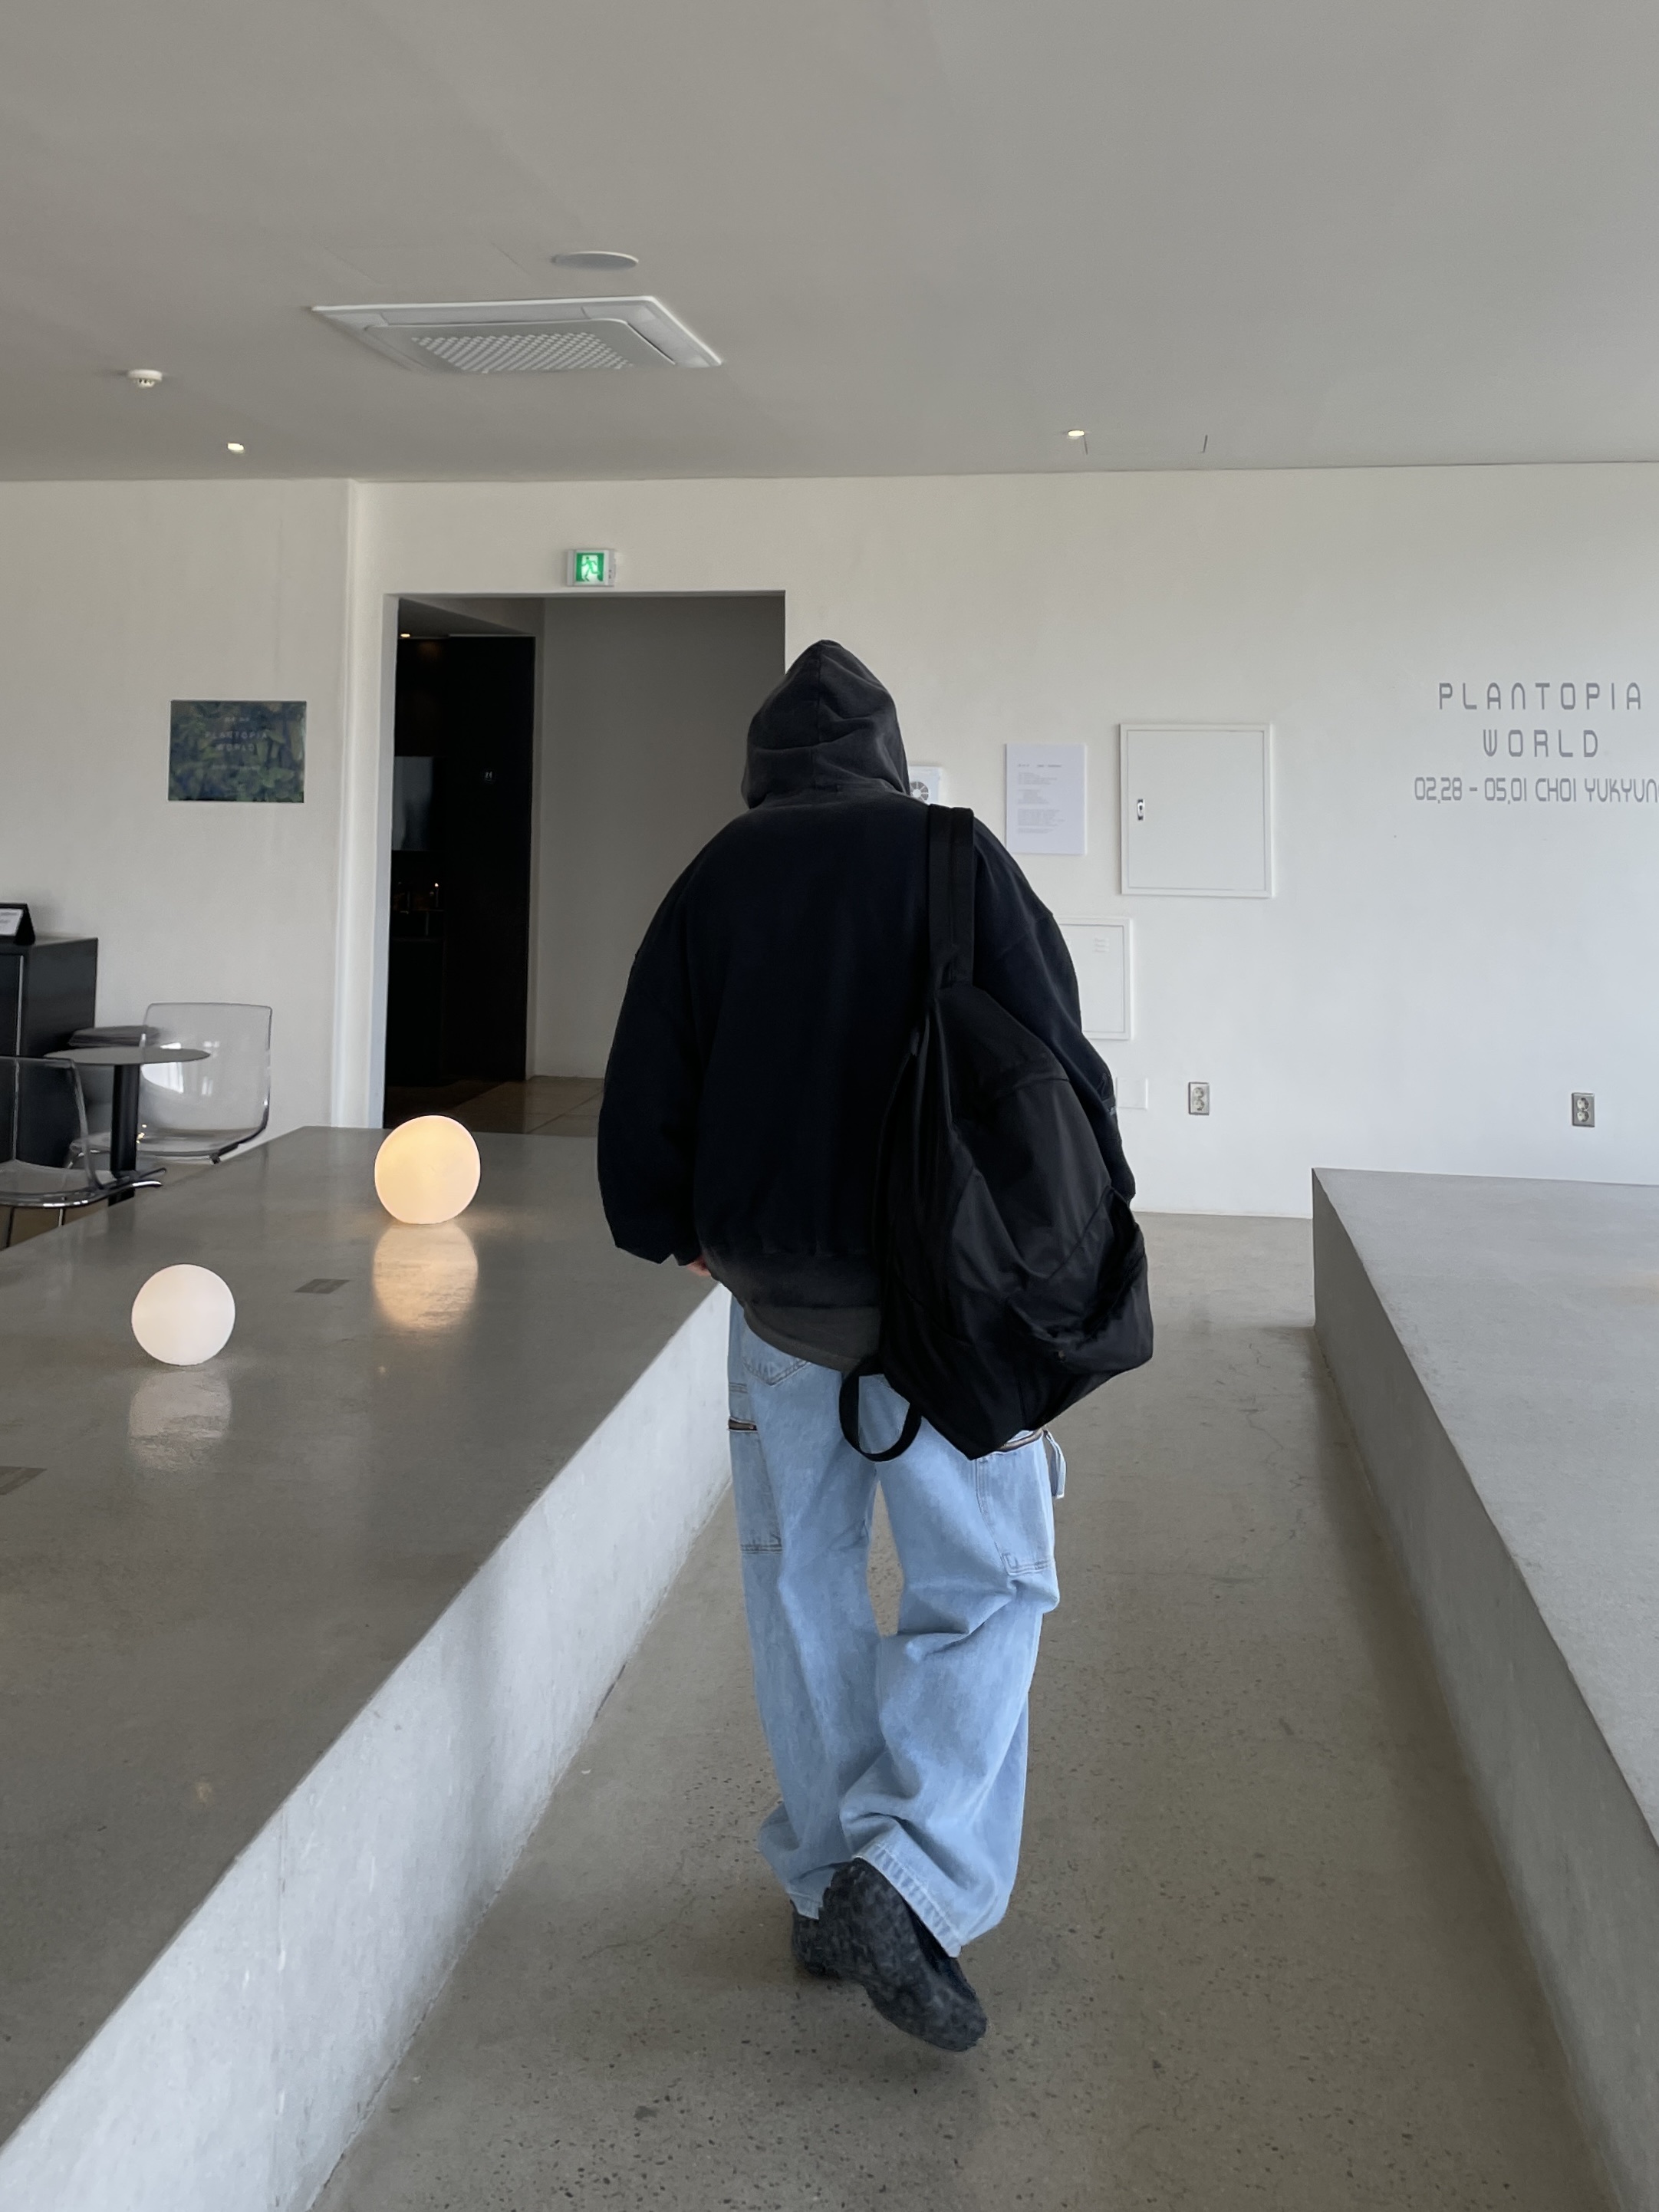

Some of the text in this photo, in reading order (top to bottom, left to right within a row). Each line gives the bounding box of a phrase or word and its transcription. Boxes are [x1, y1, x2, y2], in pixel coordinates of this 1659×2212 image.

[1438, 682, 1641, 710] PLANTOPIA
[1483, 729, 1598, 758] WORLD
[1414, 776, 1463, 805] 02.28
[1484, 777, 1527, 805] 05.01
[1535, 777, 1577, 802] CHOI
[1584, 778, 1659, 803] YUKYUN
